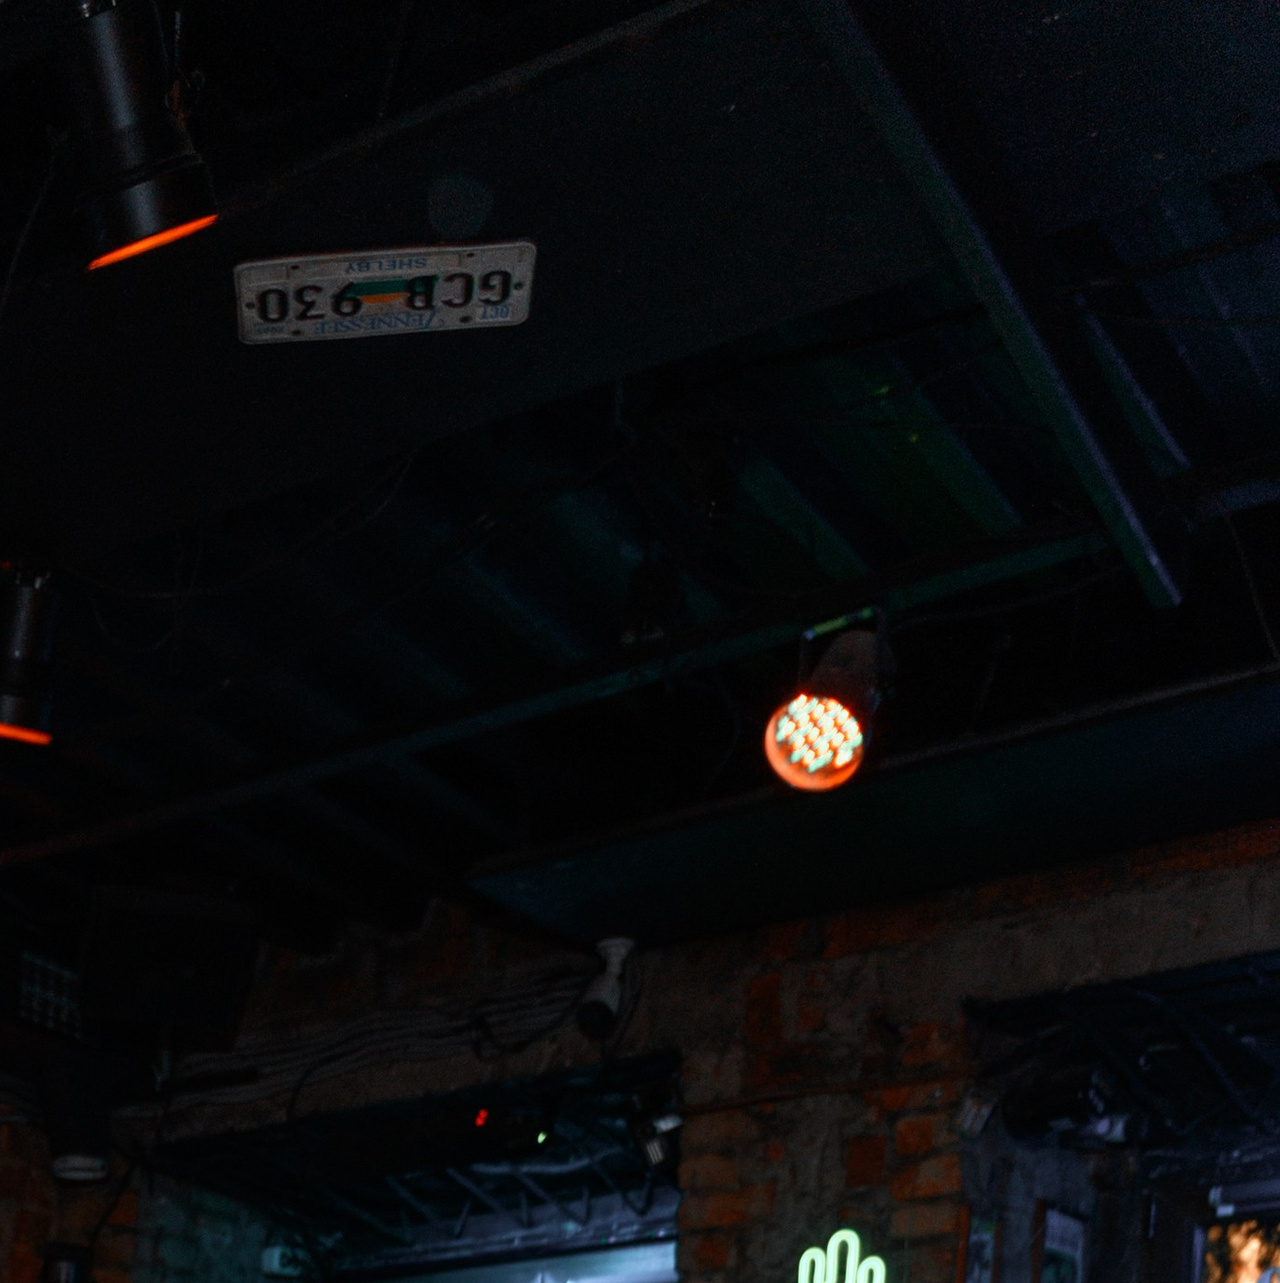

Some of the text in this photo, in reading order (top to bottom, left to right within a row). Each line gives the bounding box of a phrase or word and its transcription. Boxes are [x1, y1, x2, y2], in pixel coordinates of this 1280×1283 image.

[345, 257, 429, 275] SHELBY
[255, 269, 512, 325] GCB 930
[313, 307, 447, 337] TENNESSEE
